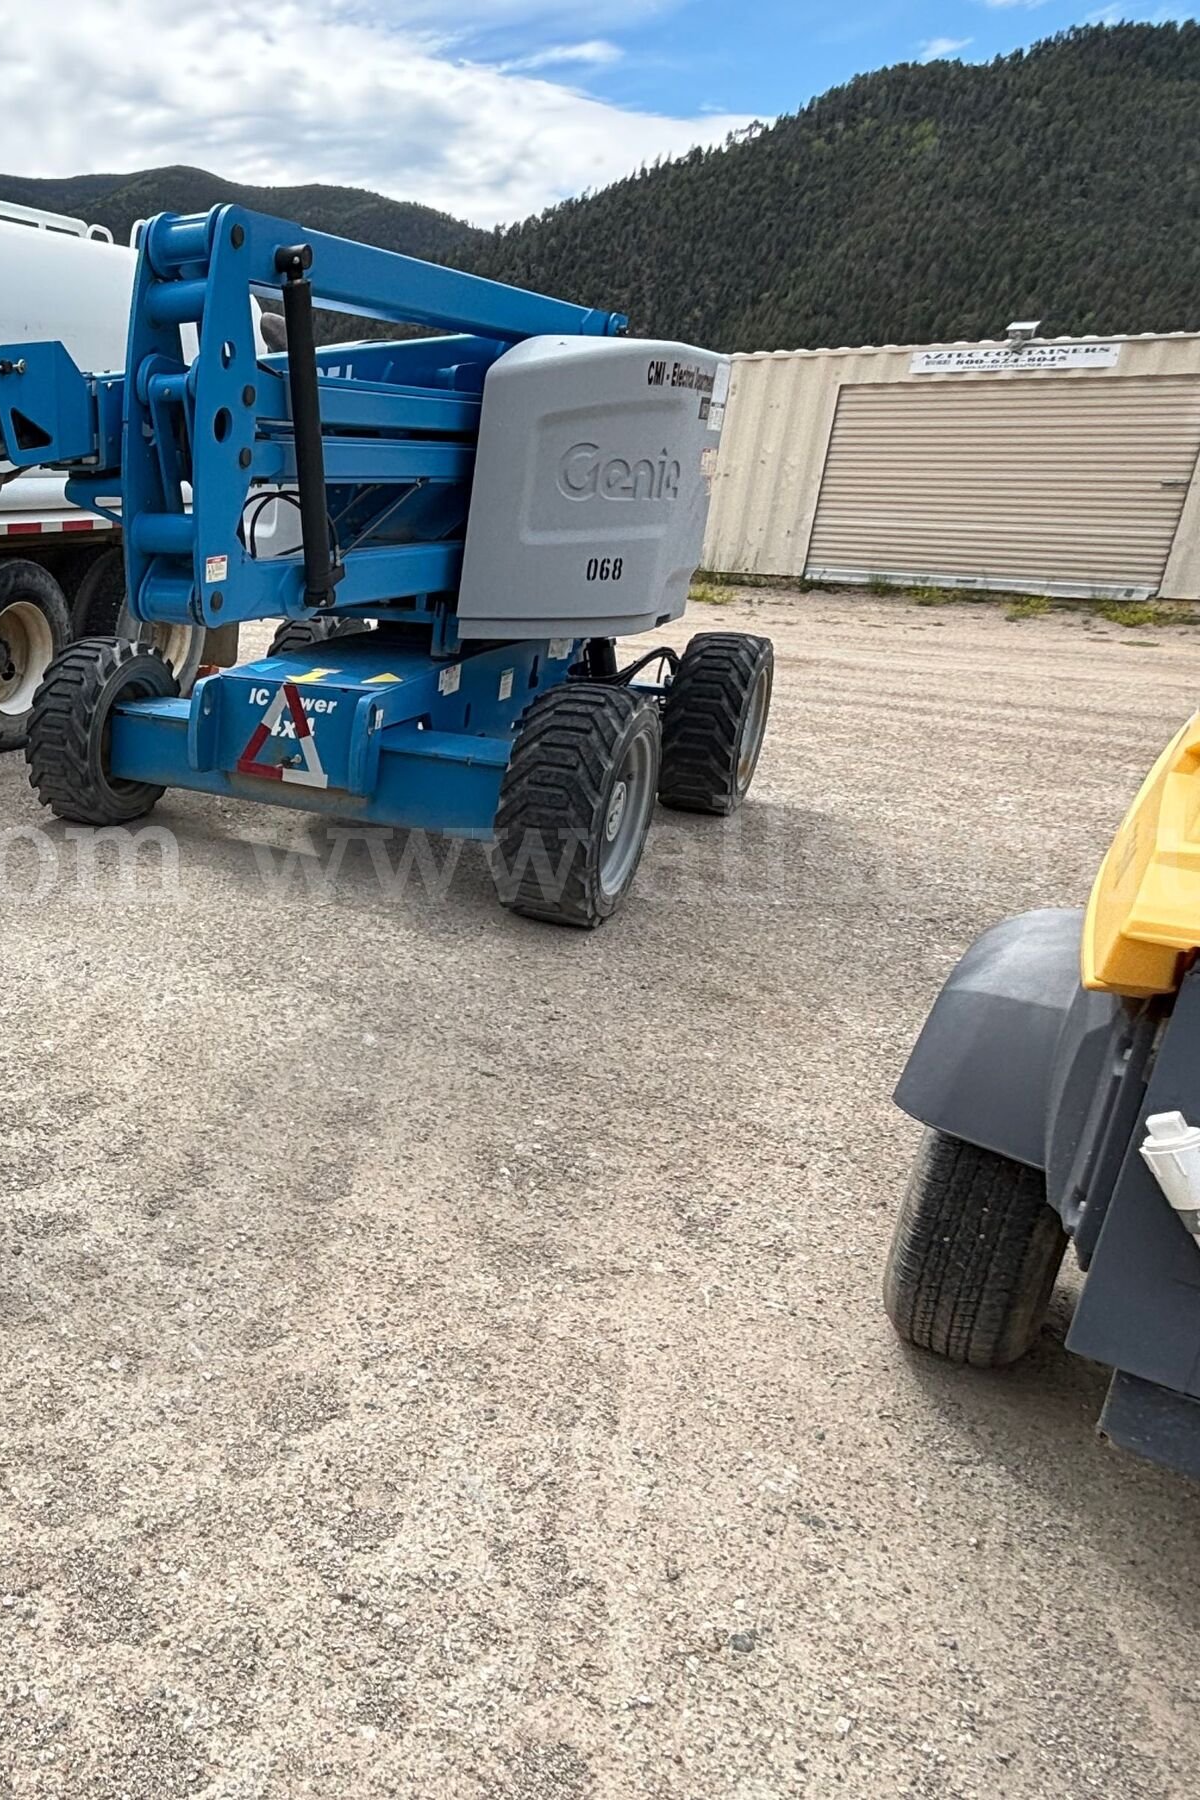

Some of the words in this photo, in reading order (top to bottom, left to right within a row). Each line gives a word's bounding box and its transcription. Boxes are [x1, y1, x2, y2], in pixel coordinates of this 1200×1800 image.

[921, 350, 977, 360] AZTEC
[984, 347, 1110, 357] CONTAINERS
[648, 361, 666, 386] CMI
[556, 442, 680, 501] Genie
[587, 557, 623, 581] 068
[248, 687, 270, 706] IC
